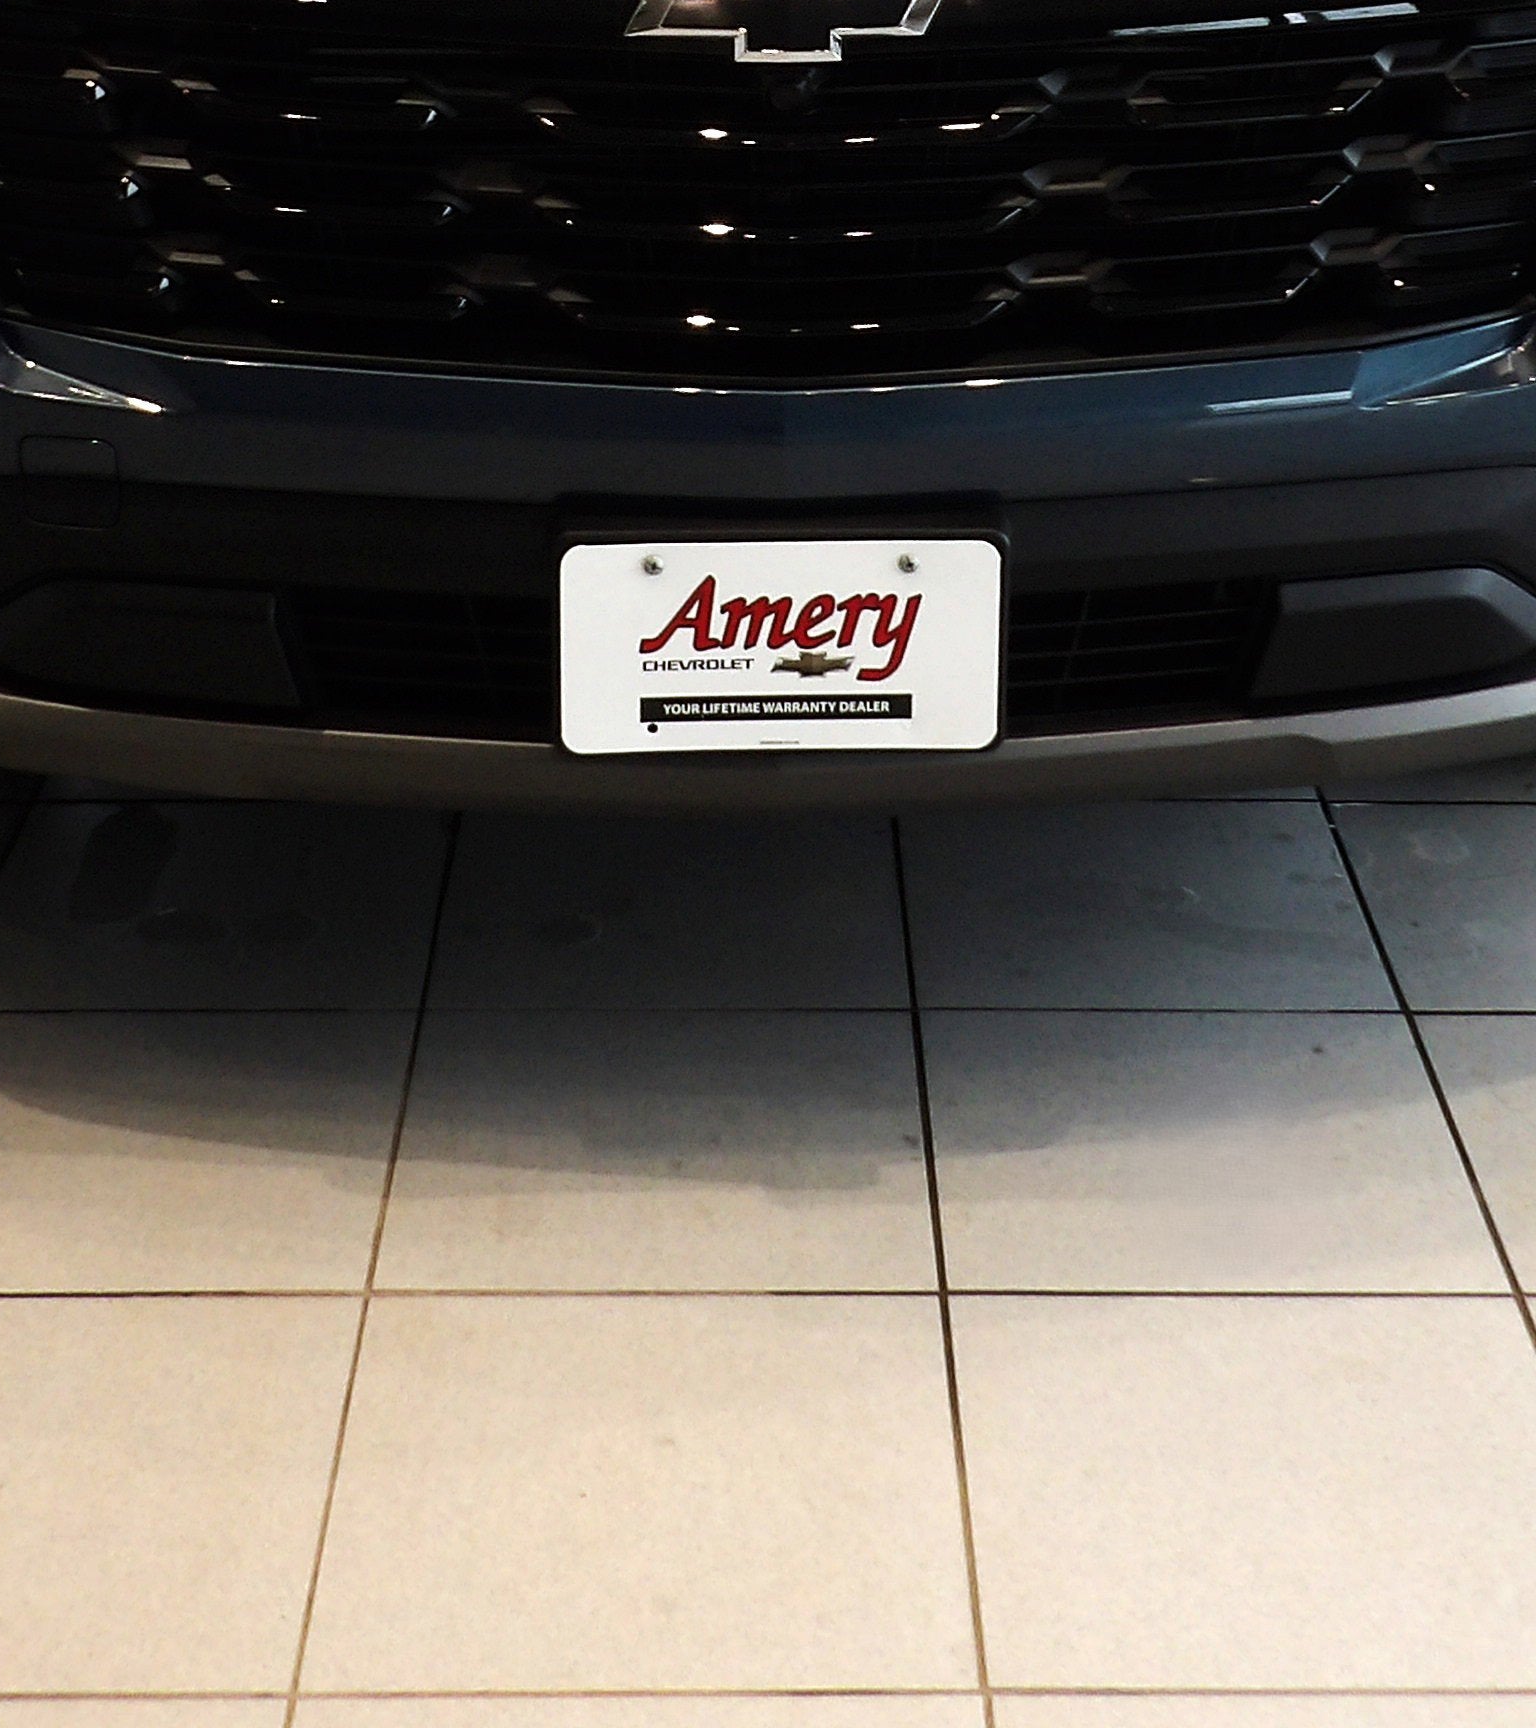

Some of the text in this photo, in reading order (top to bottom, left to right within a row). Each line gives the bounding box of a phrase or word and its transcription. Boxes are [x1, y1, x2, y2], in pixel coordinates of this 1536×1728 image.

[639, 574, 922, 681] Amery
[642, 658, 755, 672] CHEVROLET
[663, 700, 891, 715] YOUR LIFETIME WARRANTY DEALER
